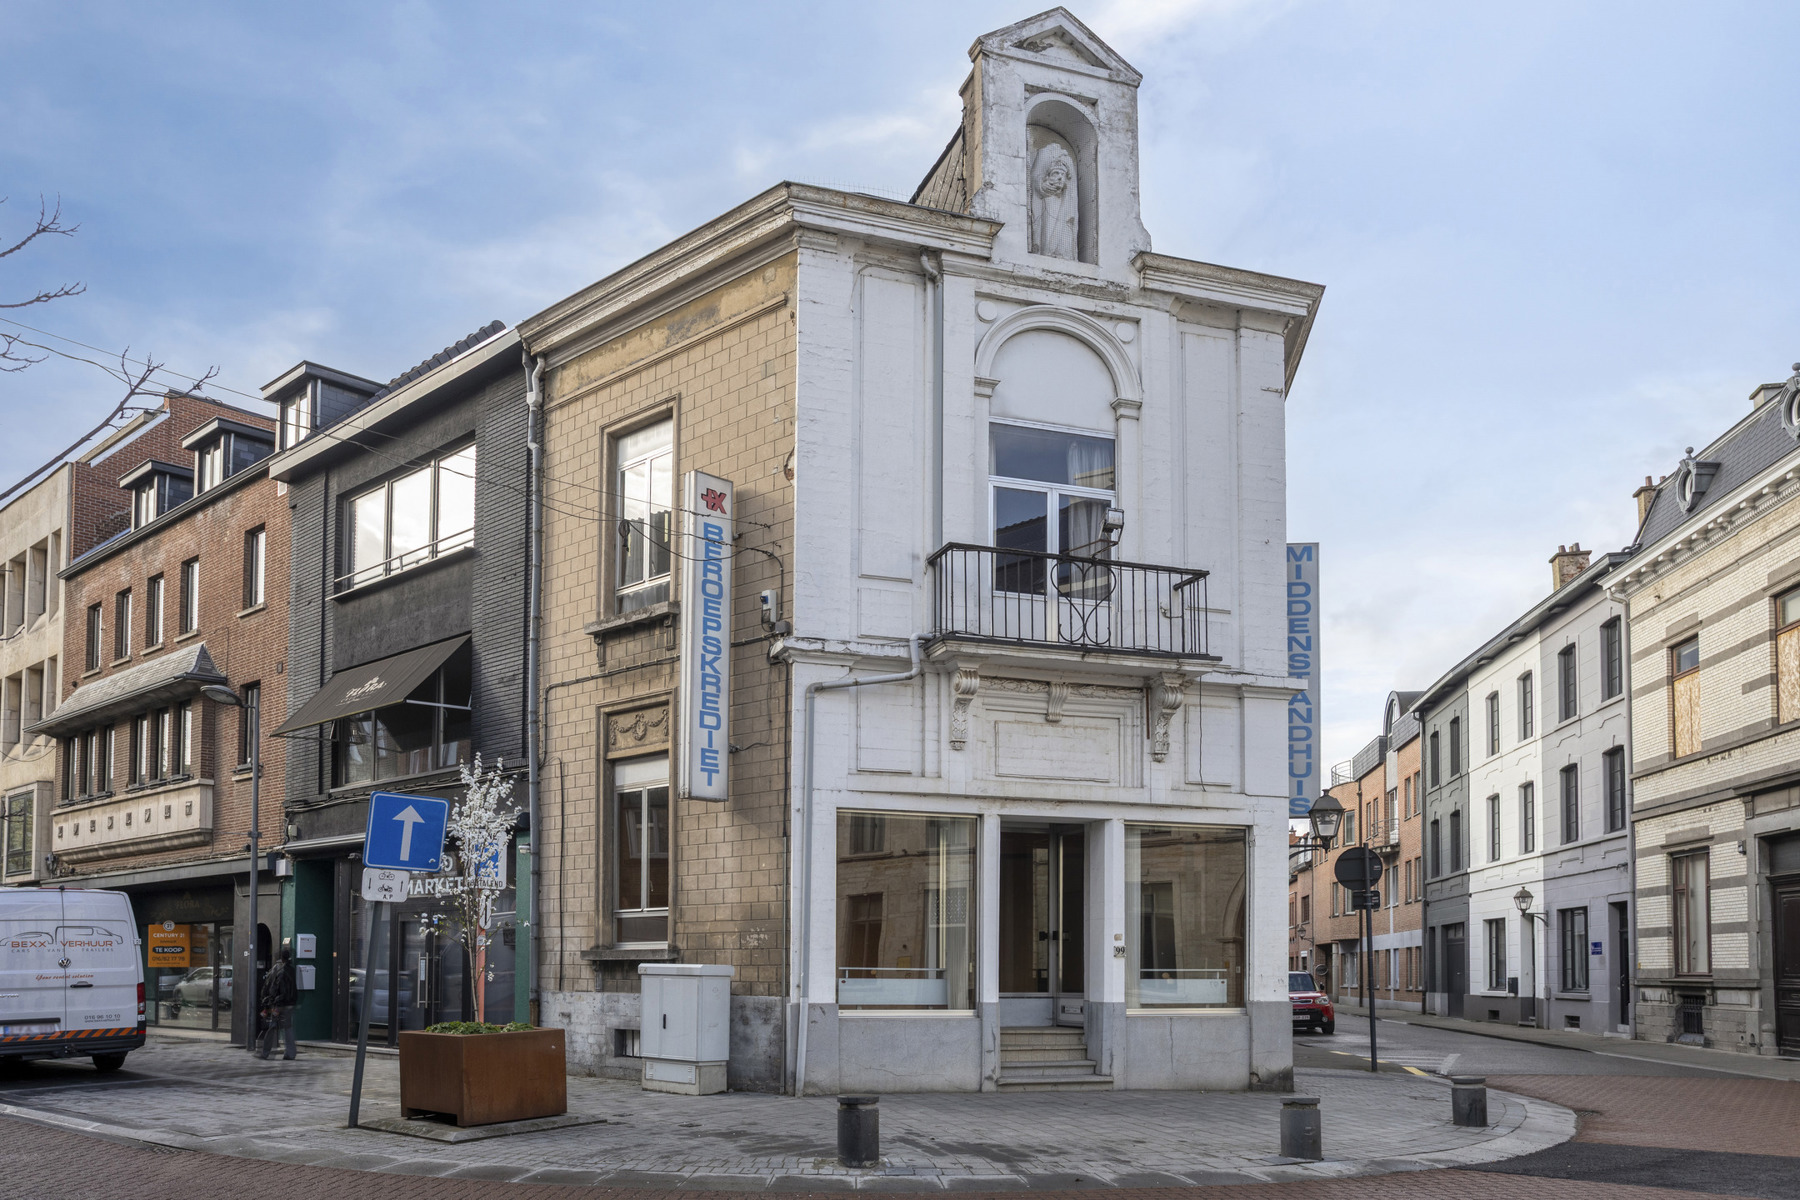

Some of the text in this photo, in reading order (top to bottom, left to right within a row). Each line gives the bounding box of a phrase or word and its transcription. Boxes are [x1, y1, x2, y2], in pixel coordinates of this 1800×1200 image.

[699, 521, 724, 787] BEROEPSKREDIET
[345, 680, 386, 698] FLORA
[11, 940, 47, 948] BEXX
